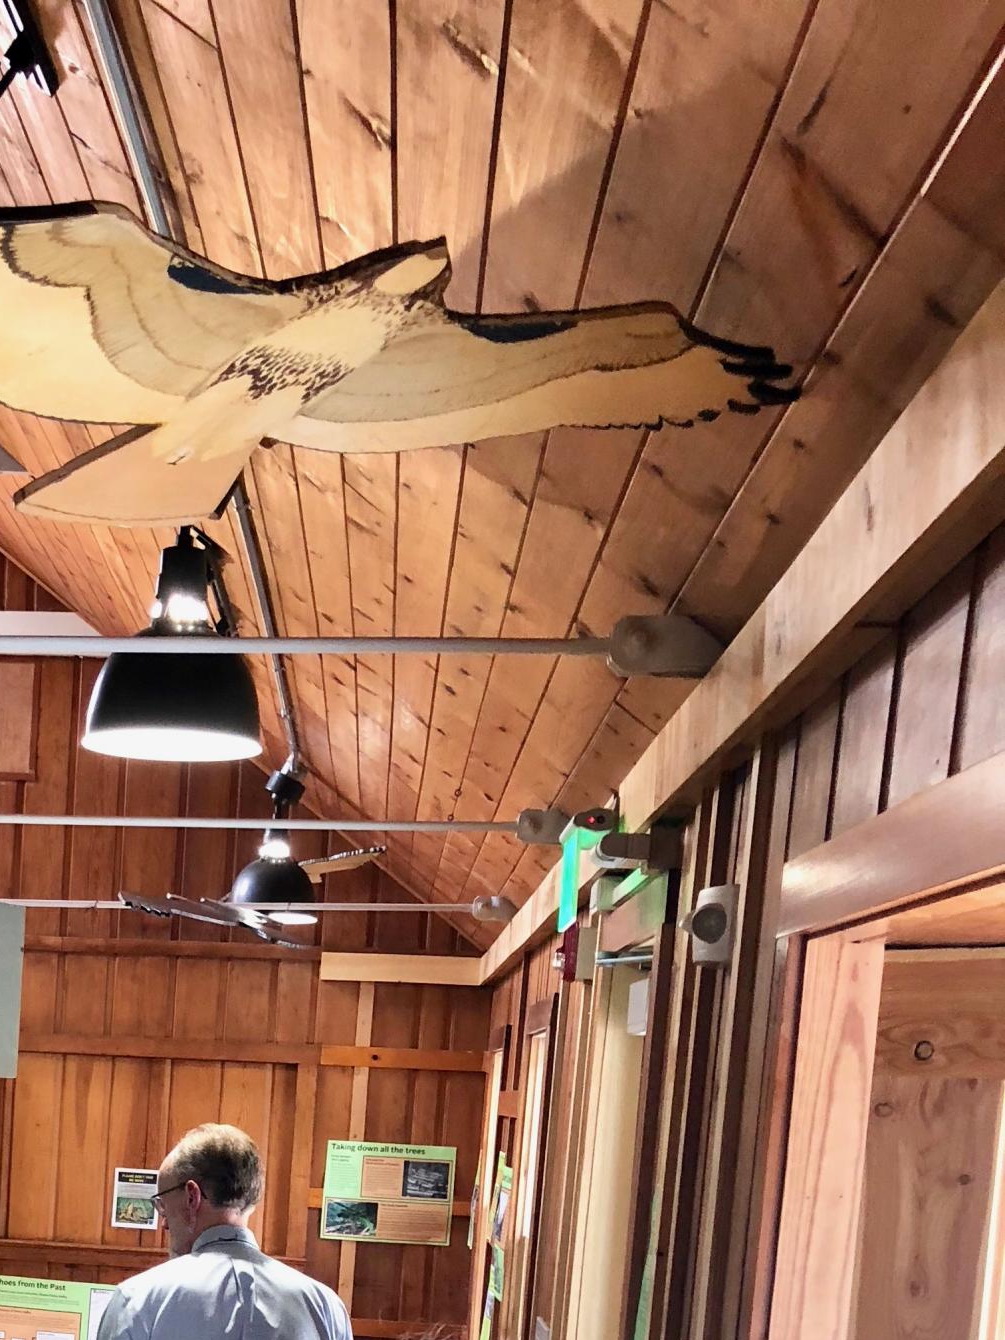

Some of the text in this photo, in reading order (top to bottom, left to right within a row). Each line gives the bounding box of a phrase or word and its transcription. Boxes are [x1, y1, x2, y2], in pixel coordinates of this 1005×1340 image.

[331, 1143, 426, 1155] Taking down all the trees
[18, 1280, 36, 1289] from
[36, 1281, 48, 1290] the
[50, 1283, 66, 1291] Past
